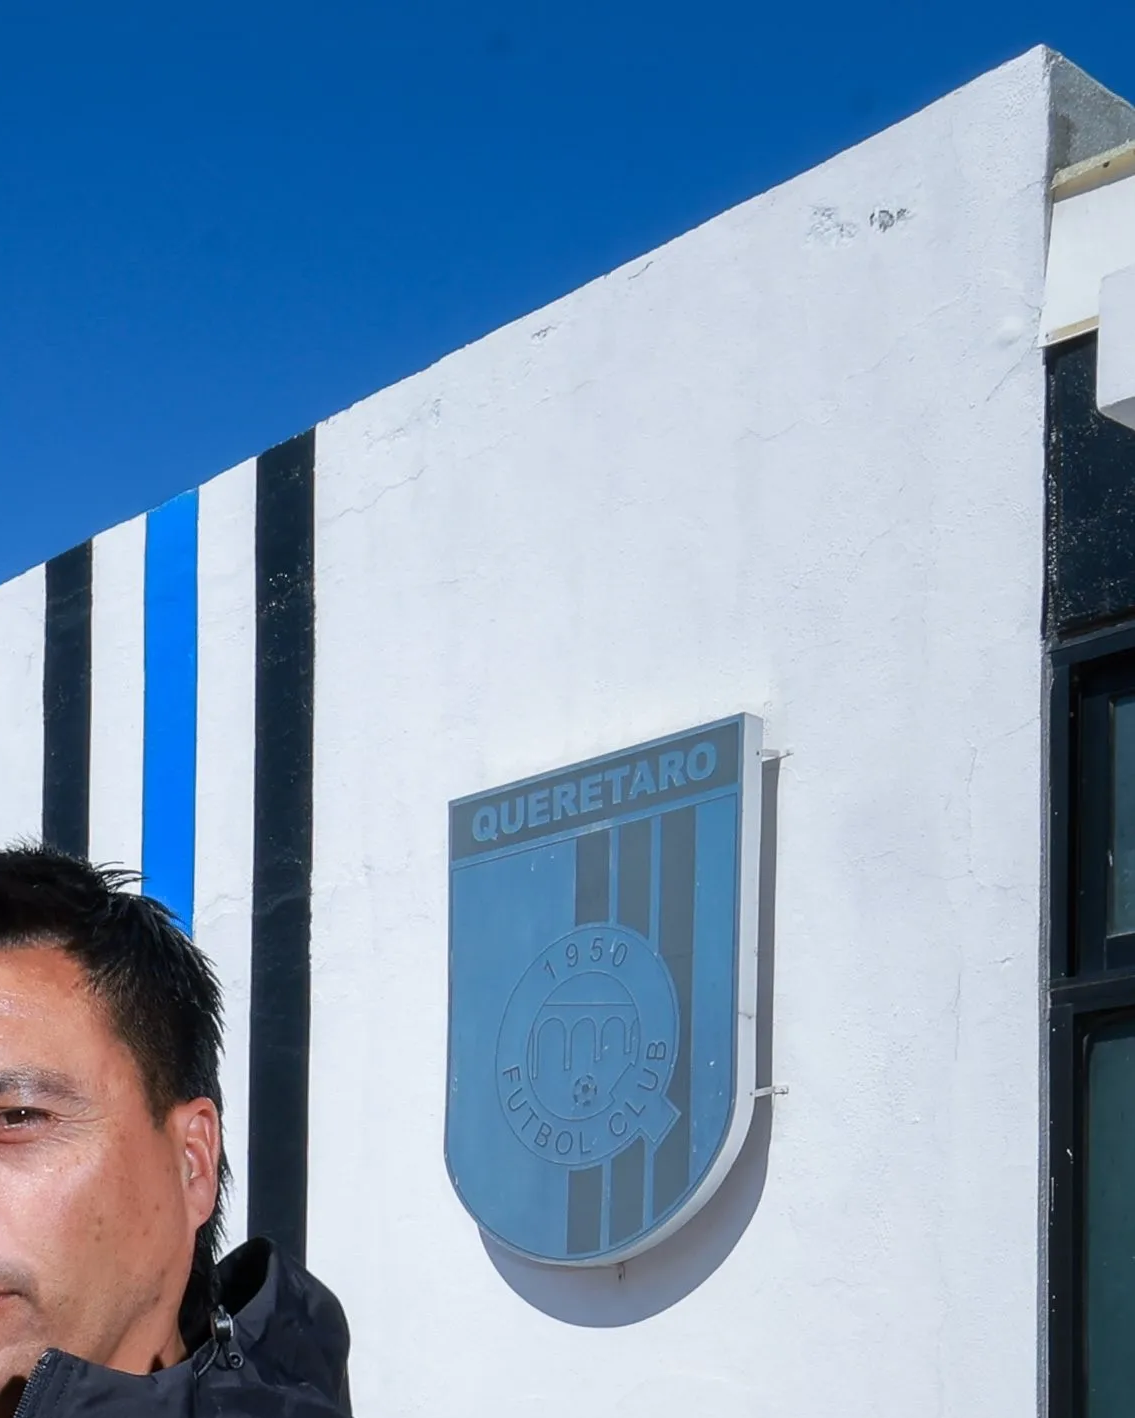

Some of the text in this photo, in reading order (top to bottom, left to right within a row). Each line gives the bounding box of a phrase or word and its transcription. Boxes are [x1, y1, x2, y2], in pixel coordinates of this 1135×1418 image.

[471, 741, 717, 842] QUERETARO
[543, 936, 629, 981] 1950
[501, 1038, 667, 1157] FUTBOL CLUB
